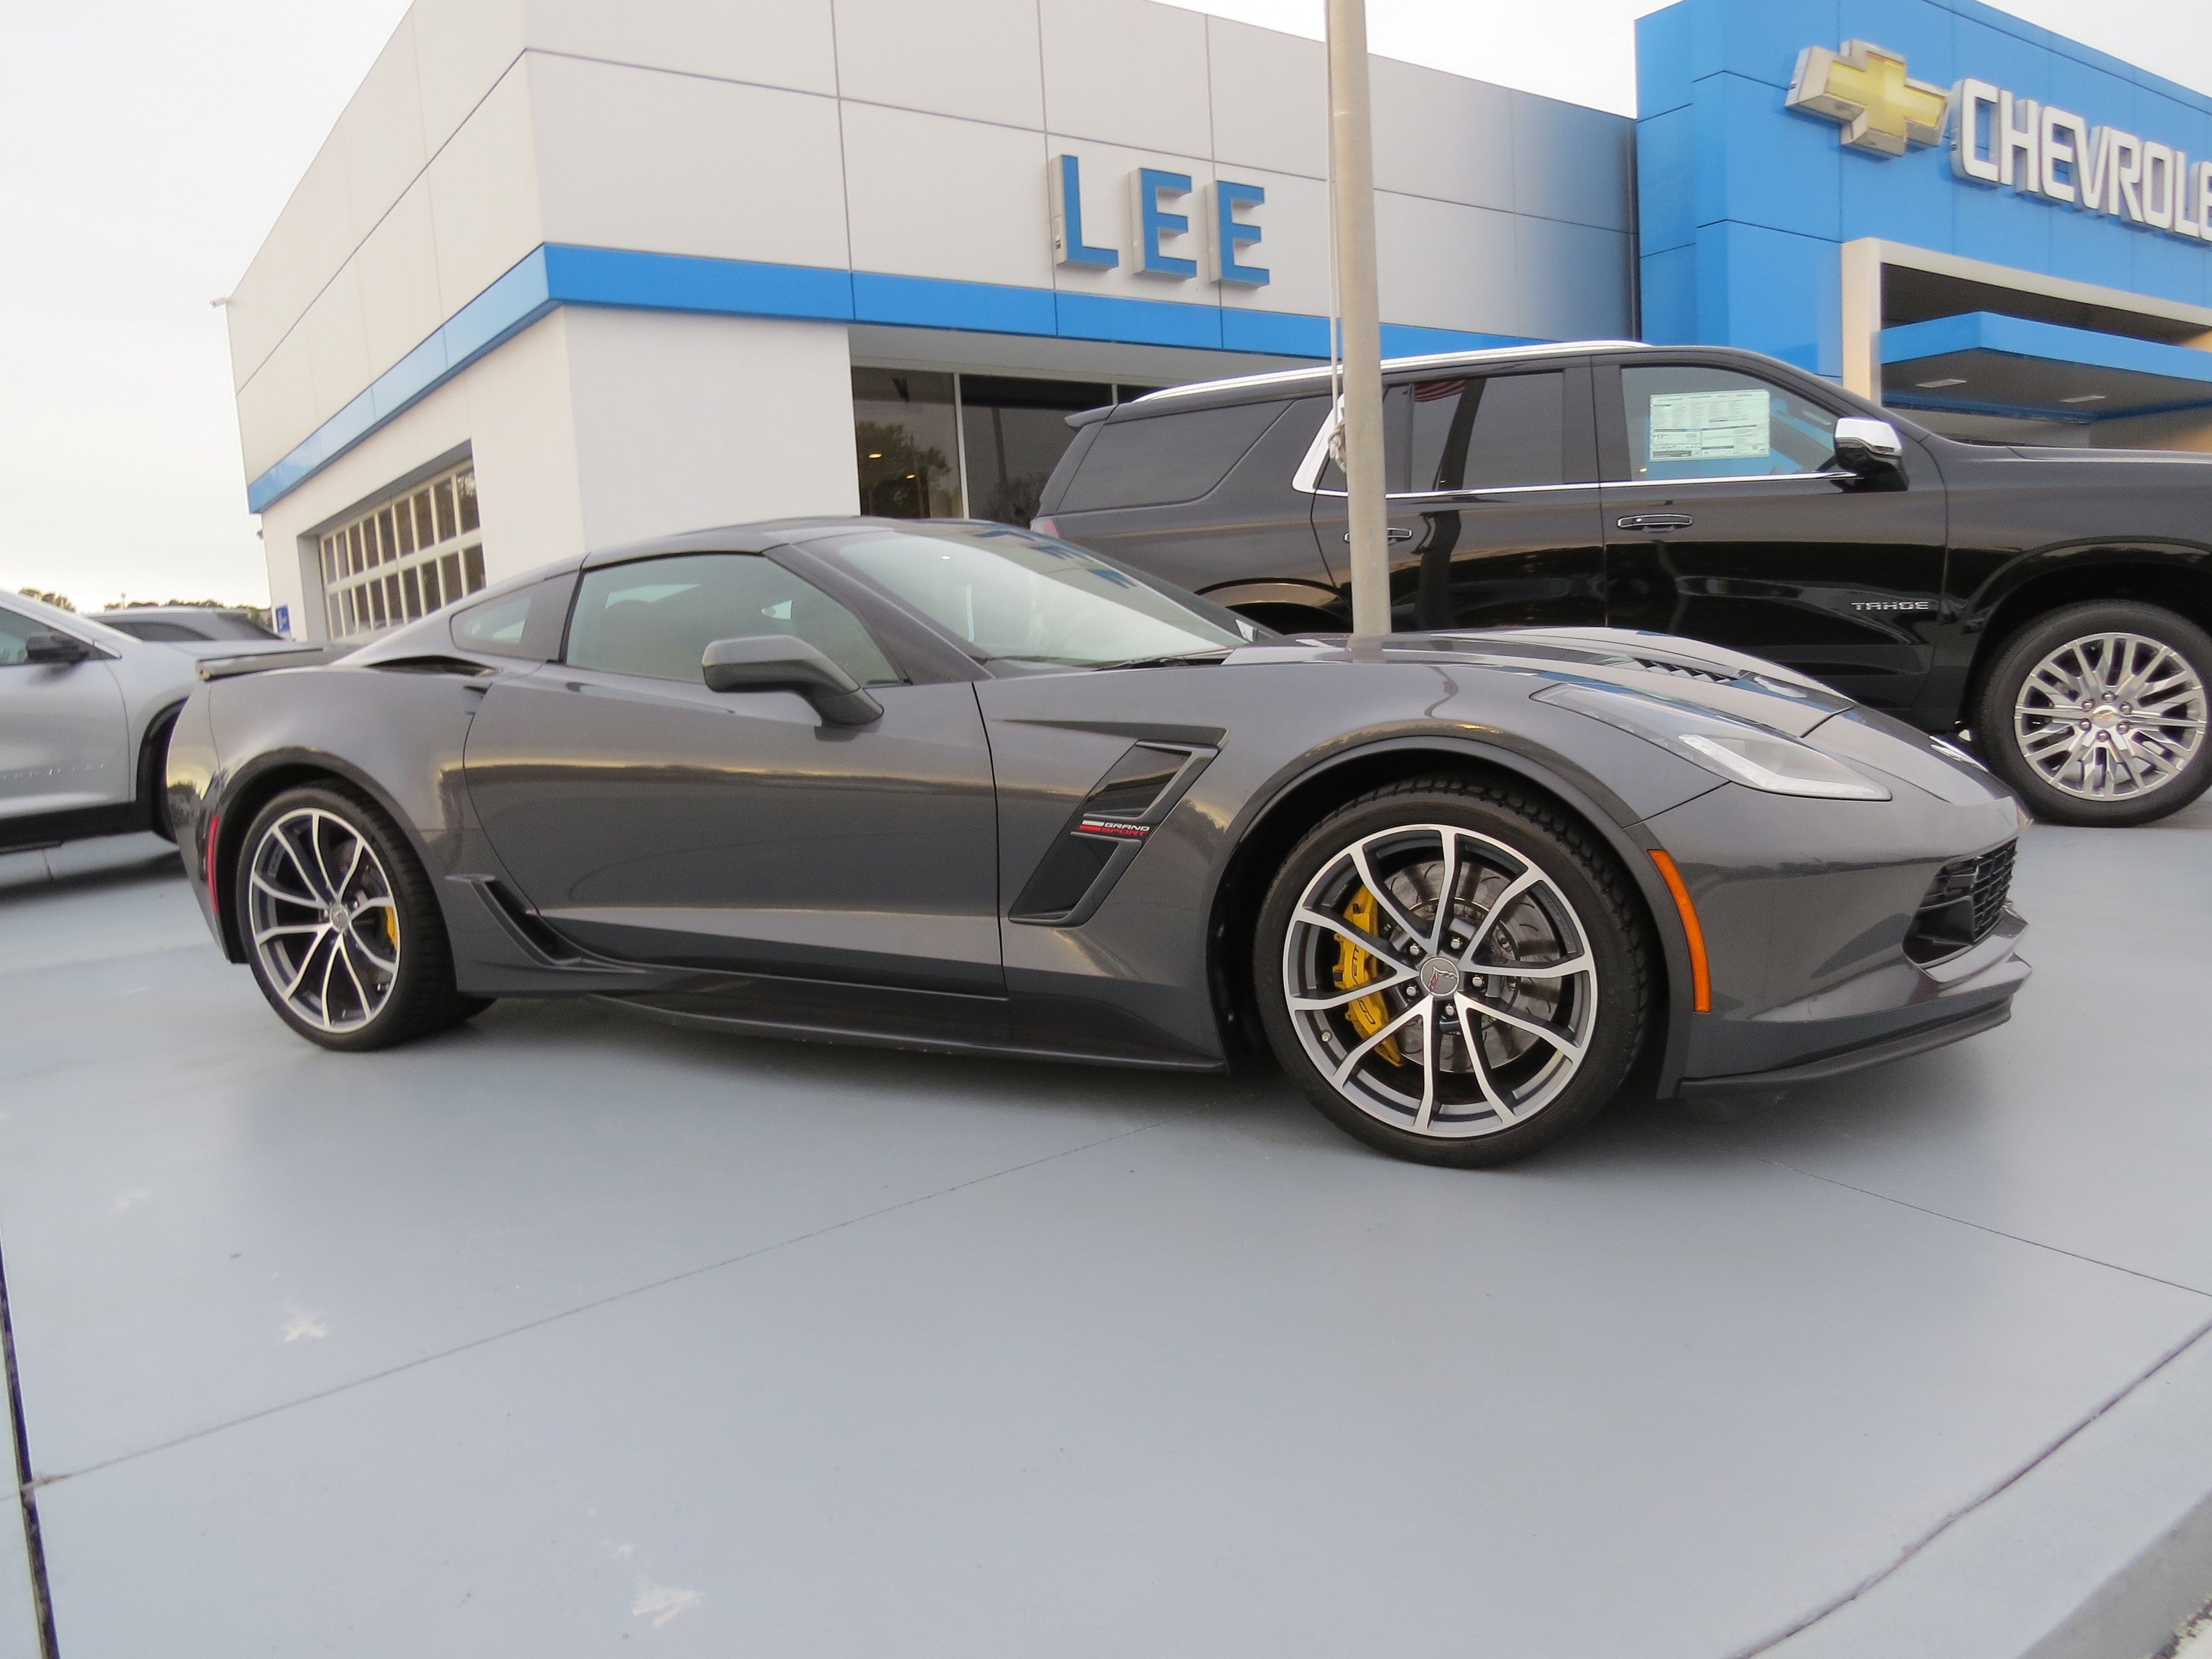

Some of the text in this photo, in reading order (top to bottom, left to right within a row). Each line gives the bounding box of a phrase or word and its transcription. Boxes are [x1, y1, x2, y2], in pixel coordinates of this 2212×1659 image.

[1058, 154, 1270, 286] LEE
[1851, 601, 1929, 611] TAHOE
[1104, 822, 1150, 831] GRAND
[1102, 827, 1147, 836] SPORT
